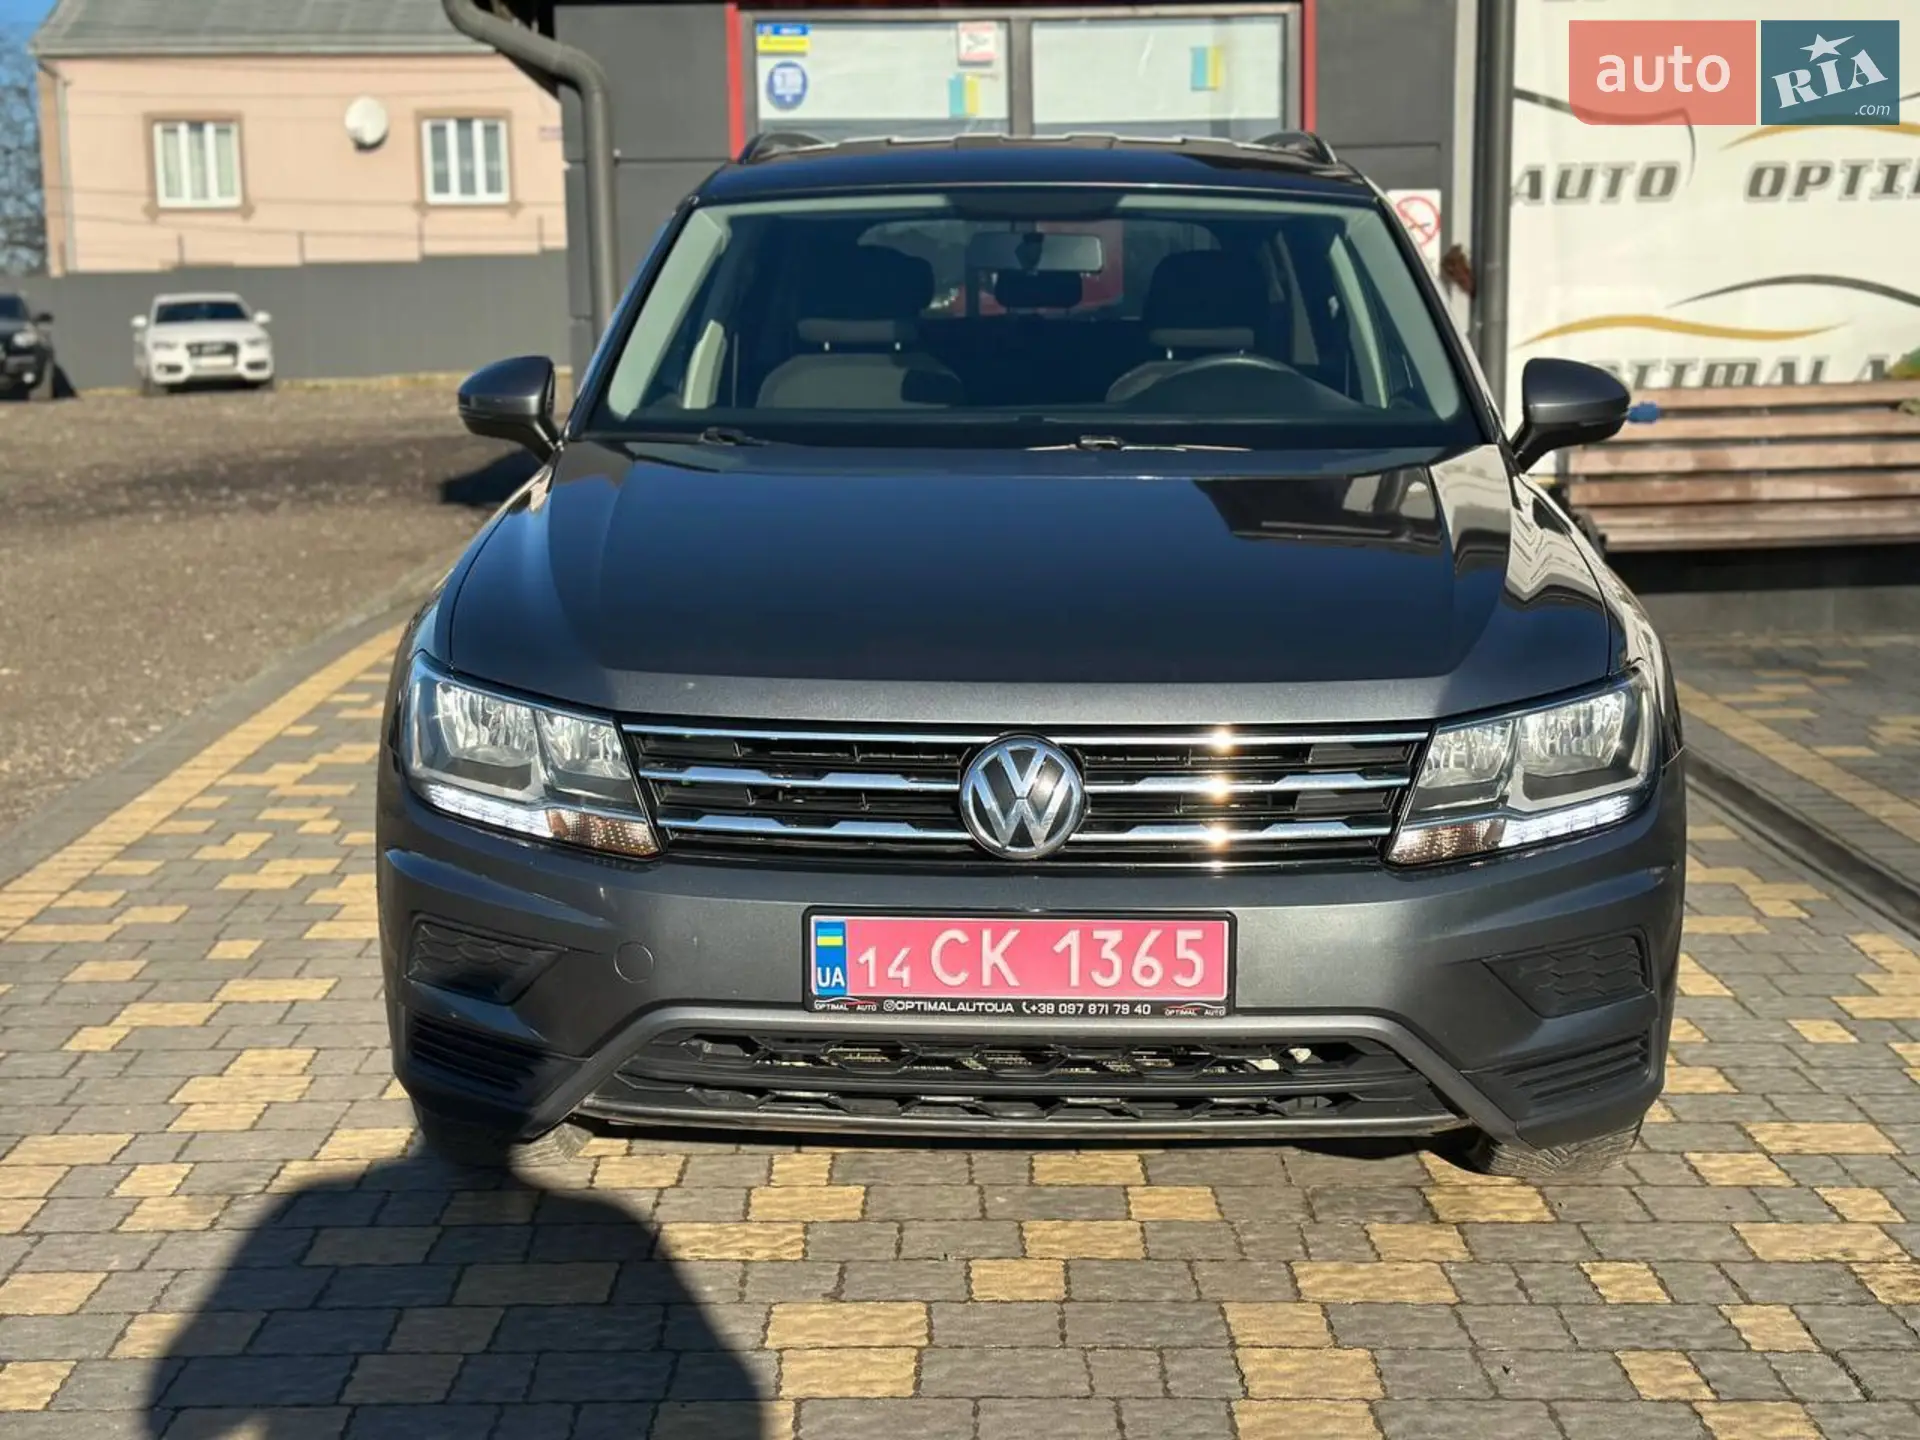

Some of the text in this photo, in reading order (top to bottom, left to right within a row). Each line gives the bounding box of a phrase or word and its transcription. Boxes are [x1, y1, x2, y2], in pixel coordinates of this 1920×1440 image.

[1511, 158, 1920, 206] AUTO OPTI
[857, 928, 1206, 988] 14 CK 1365
[817, 966, 845, 988] UA
[1031, 1002, 1151, 1015] +38 097 871 79 40
